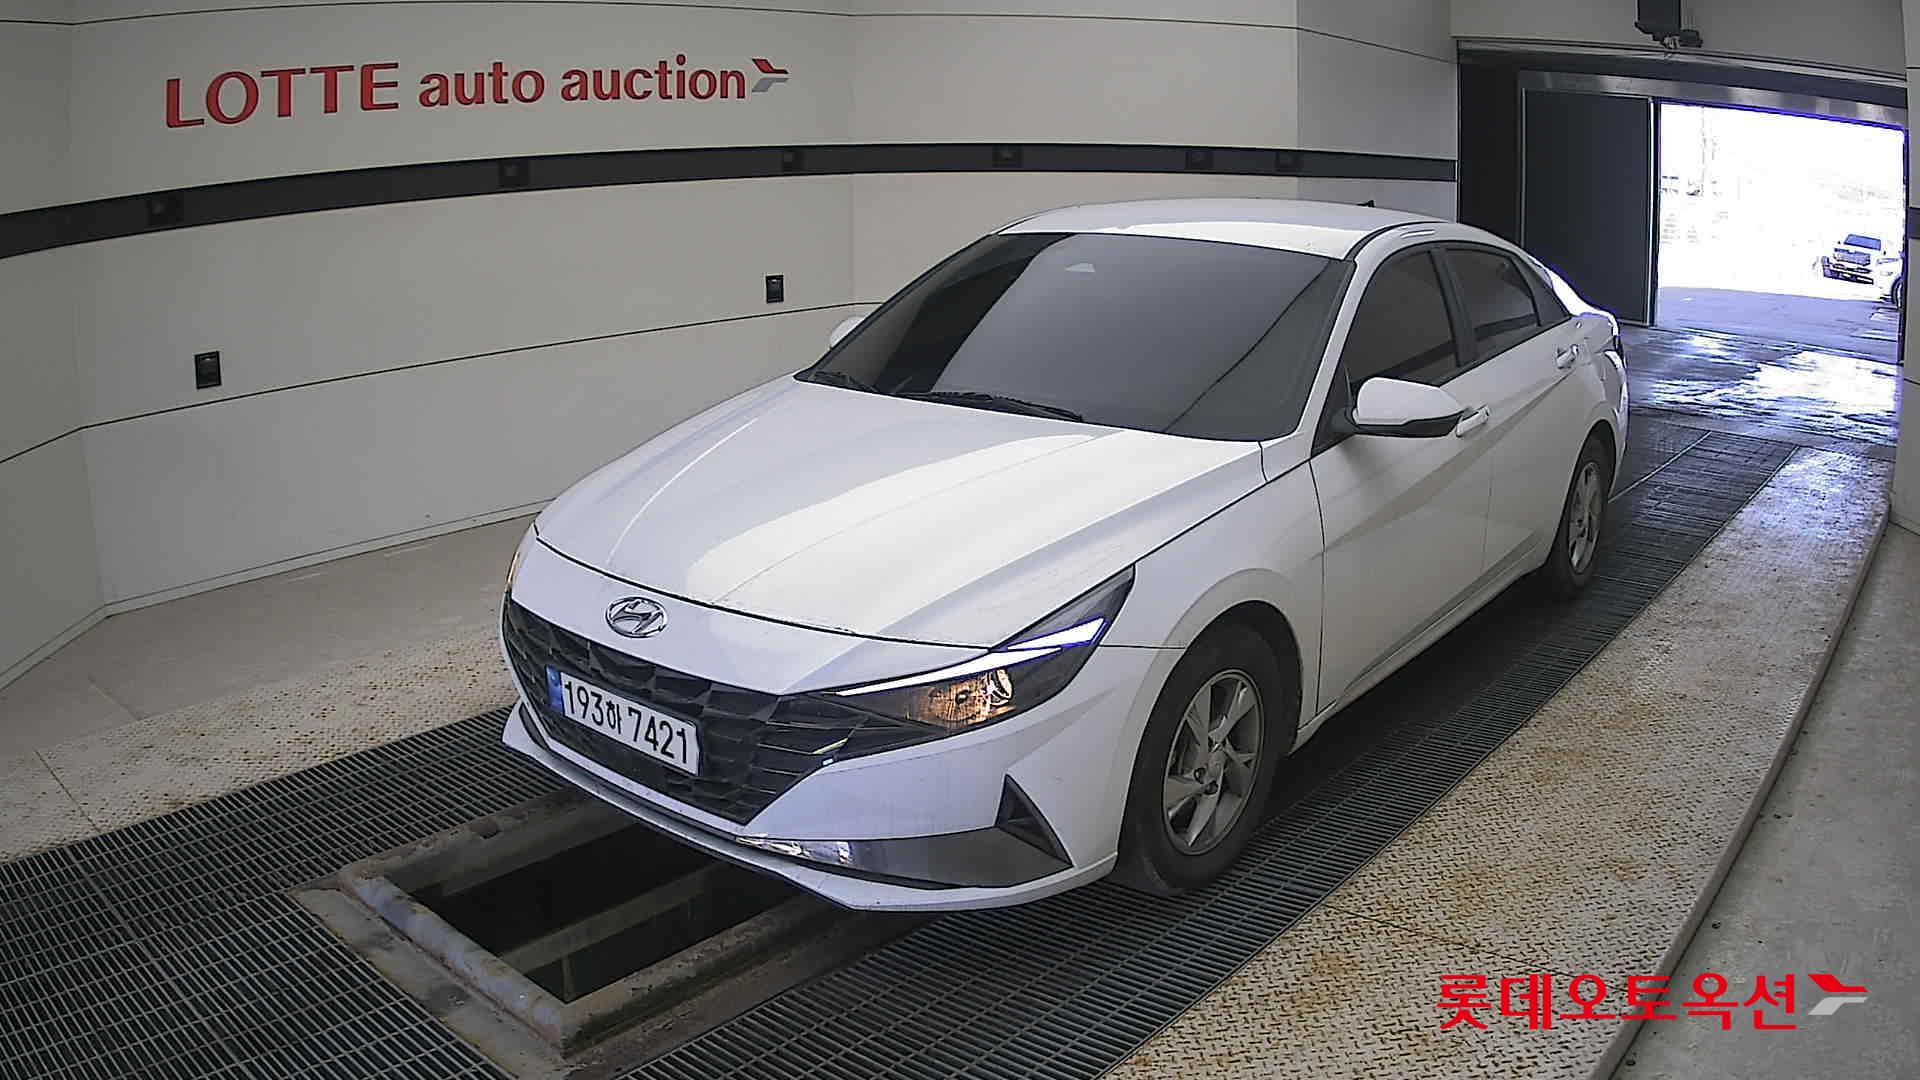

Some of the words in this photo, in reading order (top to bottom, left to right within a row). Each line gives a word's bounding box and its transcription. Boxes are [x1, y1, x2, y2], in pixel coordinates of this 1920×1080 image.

[165, 62, 399, 128] LOTTE
[418, 61, 545, 107] auto
[560, 54, 746, 100] auction
[564, 681, 622, 734] 193하
[628, 706, 687, 764] 7421
